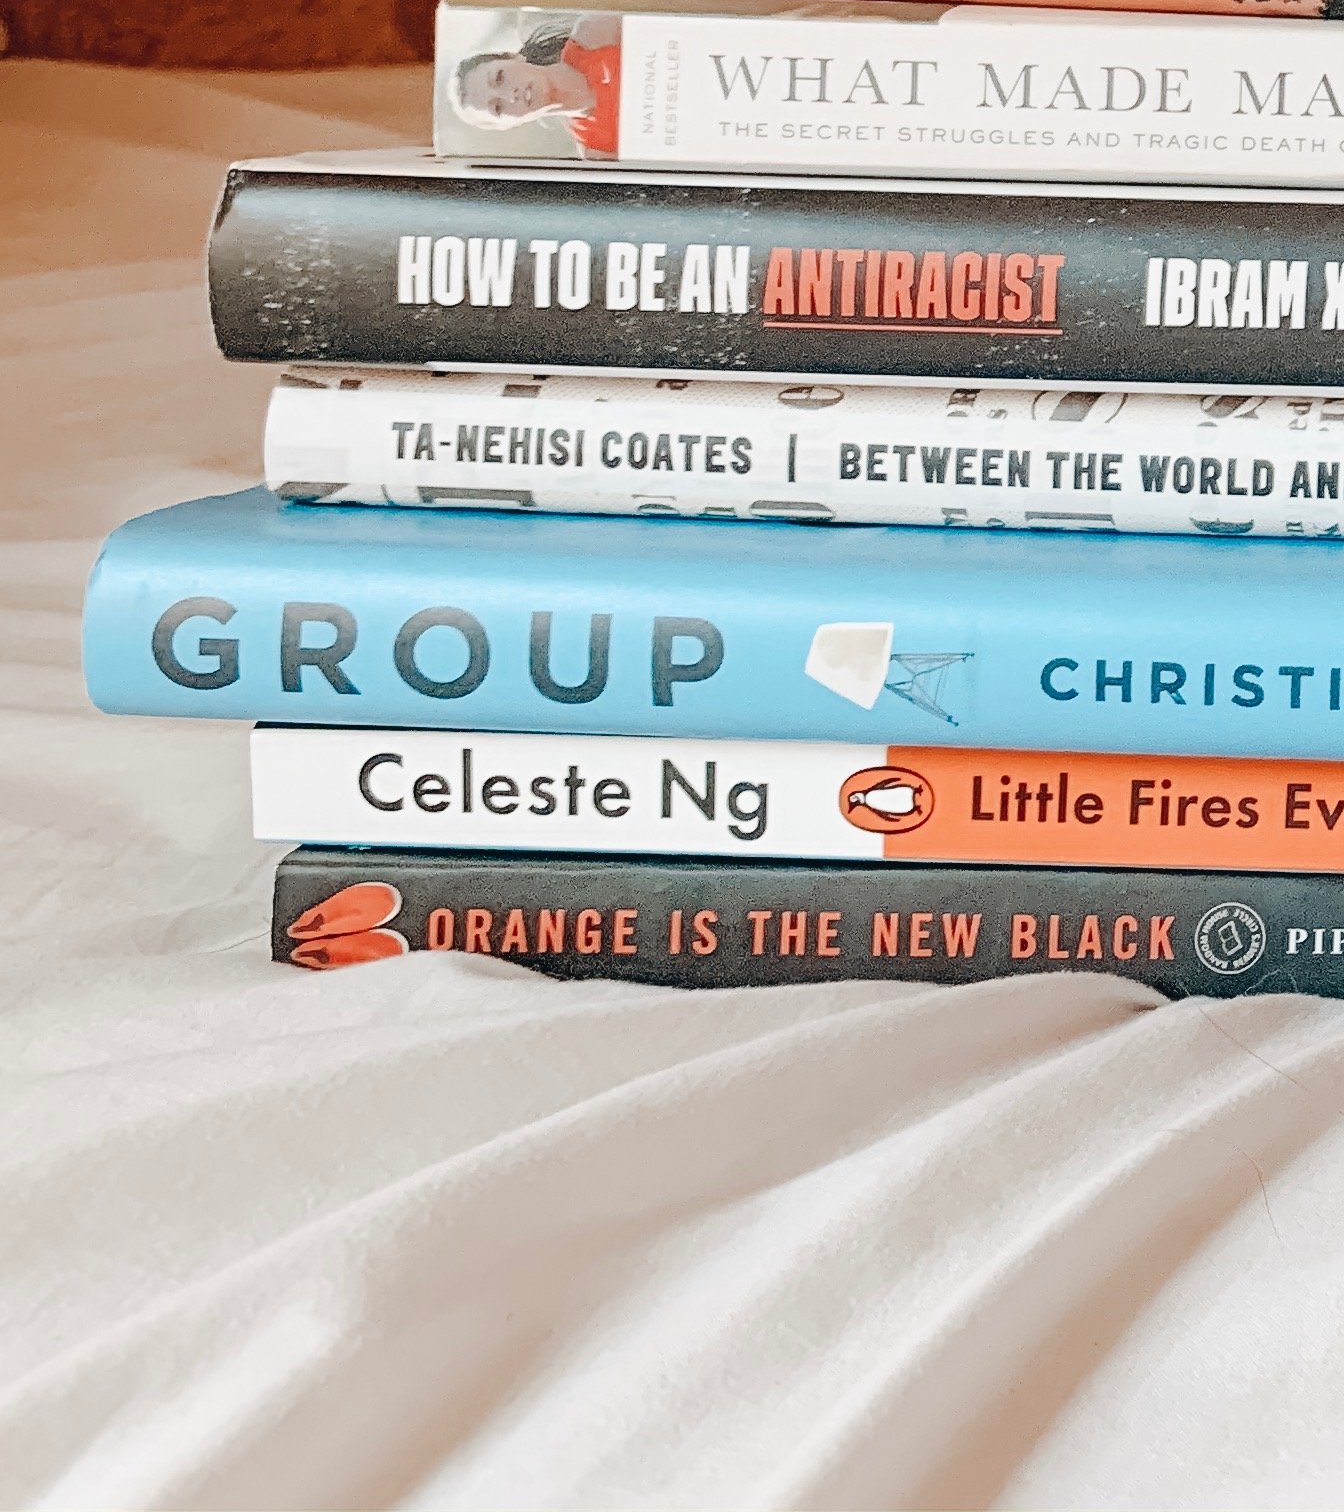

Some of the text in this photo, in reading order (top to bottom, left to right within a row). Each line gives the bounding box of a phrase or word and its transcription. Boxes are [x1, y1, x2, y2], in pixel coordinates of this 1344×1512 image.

[642, 50, 656, 134] NATIONAL
[665, 39, 679, 146] BESTSELLER
[709, 55, 938, 106] WHAT
[976, 63, 1194, 113] MADE
[719, 120, 768, 138] THE
[782, 124, 887, 142] SECRET
[899, 127, 1056, 146] STRUGGLES
[1067, 132, 1119, 148] AND
[1132, 133, 1228, 150] TRAGIC
[1241, 135, 1326, 153] DEATH
[398, 236, 1065, 322] HOW TO BE AN ANTIRACIST
[1146, 257, 1309, 330] IBRAM
[392, 421, 752, 474] TA-NEHISI COATES
[840, 443, 1031, 488] BETWEEN
[1047, 452, 1123, 491] THE
[1140, 455, 1275, 497] WORLD
[152, 596, 724, 706] GROUP
[358, 748, 769, 840] Celeste Ng
[972, 773, 1103, 825] Little
[1130, 780, 1259, 830] Fires
[427, 907, 1175, 961] ORANGE IS THE NEW BLACK
